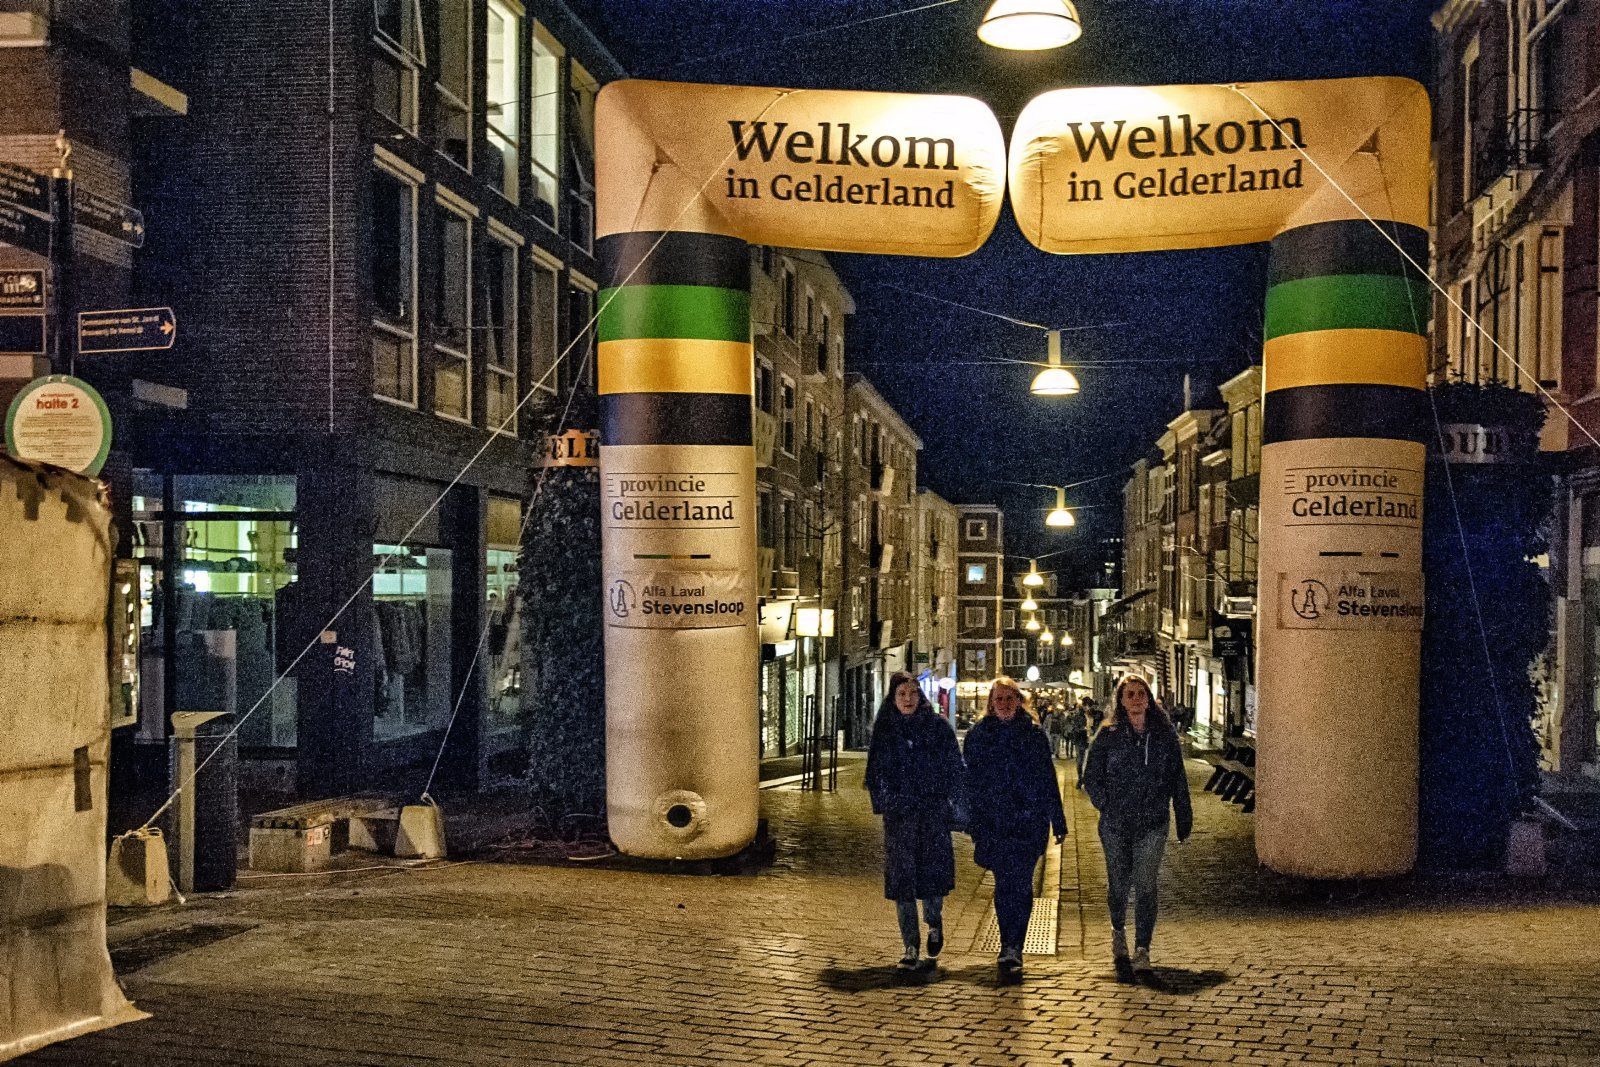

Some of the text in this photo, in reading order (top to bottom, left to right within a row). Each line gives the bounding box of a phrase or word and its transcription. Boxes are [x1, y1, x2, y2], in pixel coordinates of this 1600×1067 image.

[727, 120, 959, 171] Welkom
[1066, 113, 1307, 163] Welkom
[725, 168, 955, 209] in Gelderland
[1067, 159, 1304, 202] in Gelderland
[36, 398, 80, 409] halte 2
[620, 475, 706, 496] provincie
[1306, 469, 1398, 492] provincie
[612, 501, 734, 521] Gelderland
[1292, 496, 1418, 519] Gelderland
[642, 586, 705, 597] Alfa Laval
[1338, 585, 1400, 598] Alfa Laval
[642, 600, 744, 616] Stevensloop
